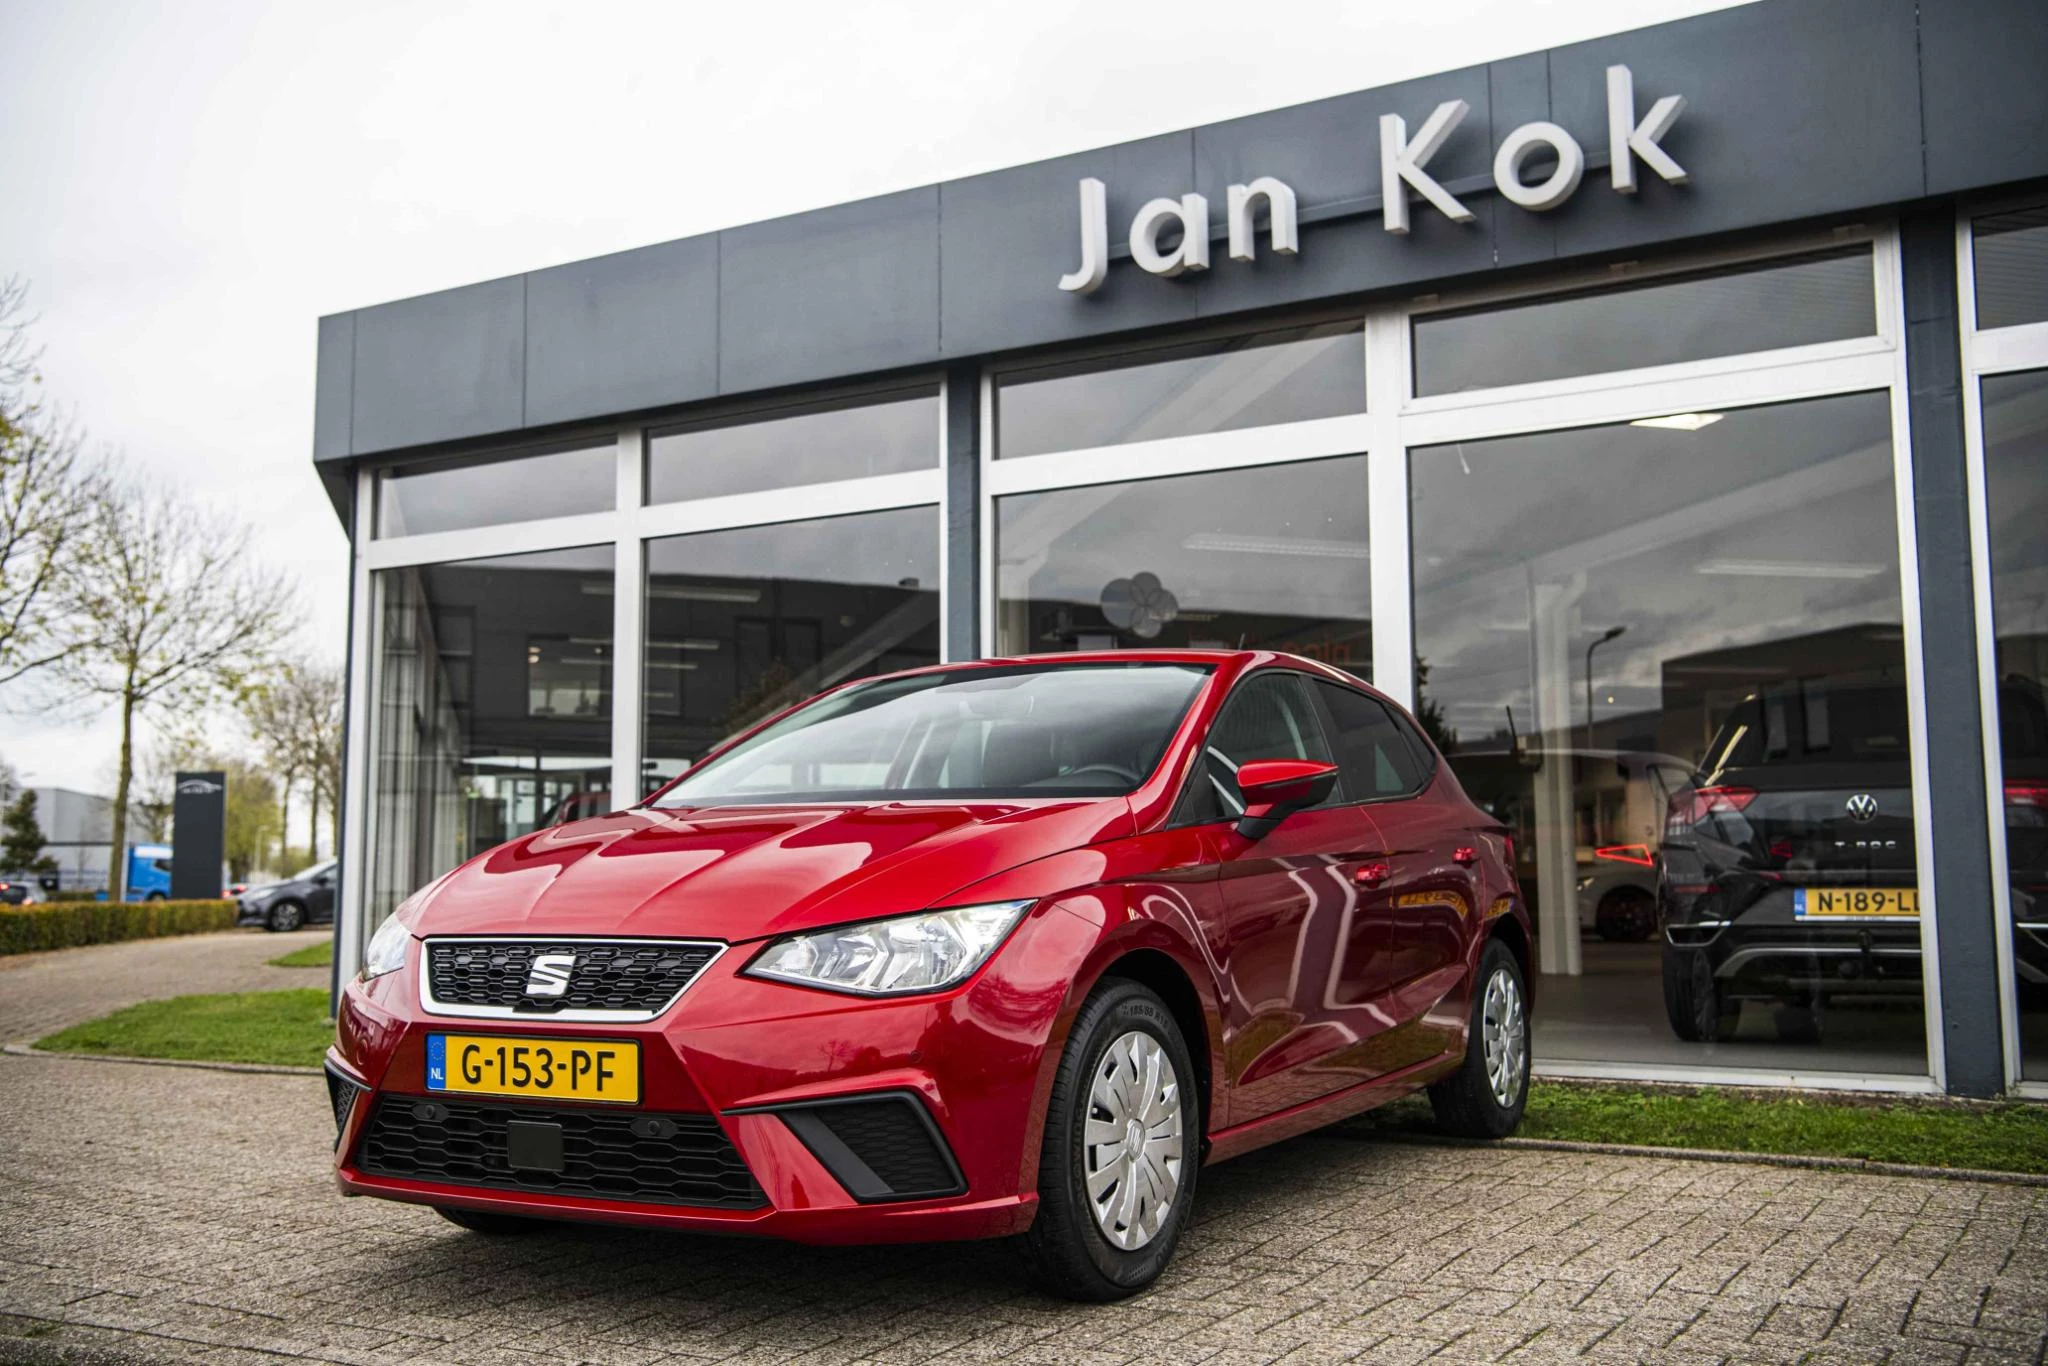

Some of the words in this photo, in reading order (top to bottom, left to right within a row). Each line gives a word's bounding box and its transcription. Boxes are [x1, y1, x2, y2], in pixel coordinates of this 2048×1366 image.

[1058, 177, 1298, 294] Jan
[1379, 64, 1689, 234] Kok
[430, 1067, 444, 1080] NL
[462, 1044, 615, 1091] G-153-PF
